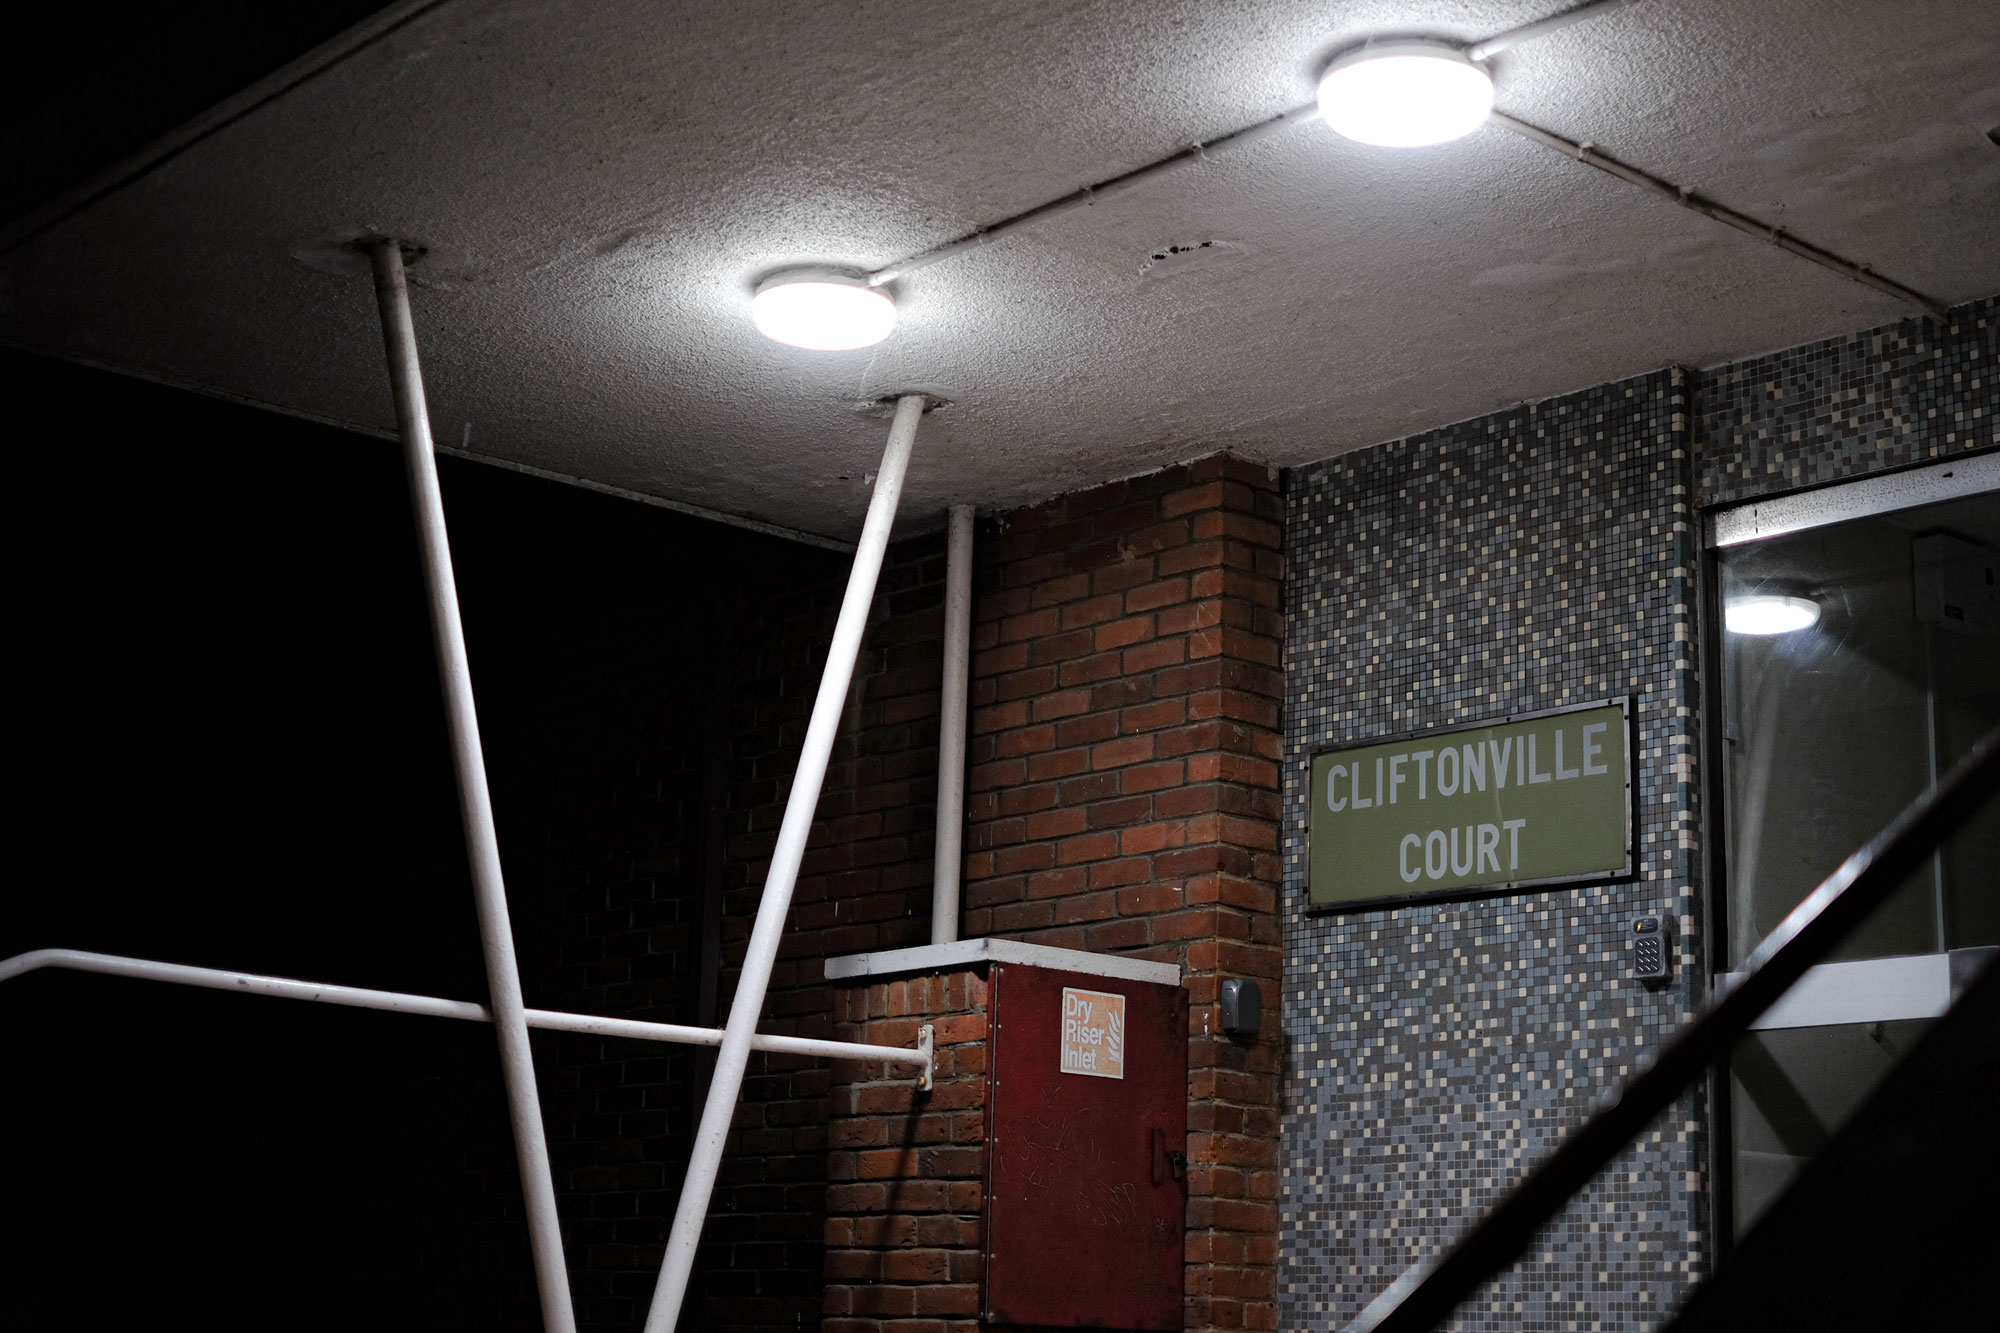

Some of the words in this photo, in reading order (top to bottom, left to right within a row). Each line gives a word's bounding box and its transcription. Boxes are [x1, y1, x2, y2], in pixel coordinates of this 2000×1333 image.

[1327, 722, 1608, 812] CLIFTONVILLE
[1399, 819, 1526, 883] COURT
[1066, 993, 1092, 1024] Dry
[1066, 1018, 1105, 1045] Riser
[1064, 1044, 1096, 1071] Inlet
